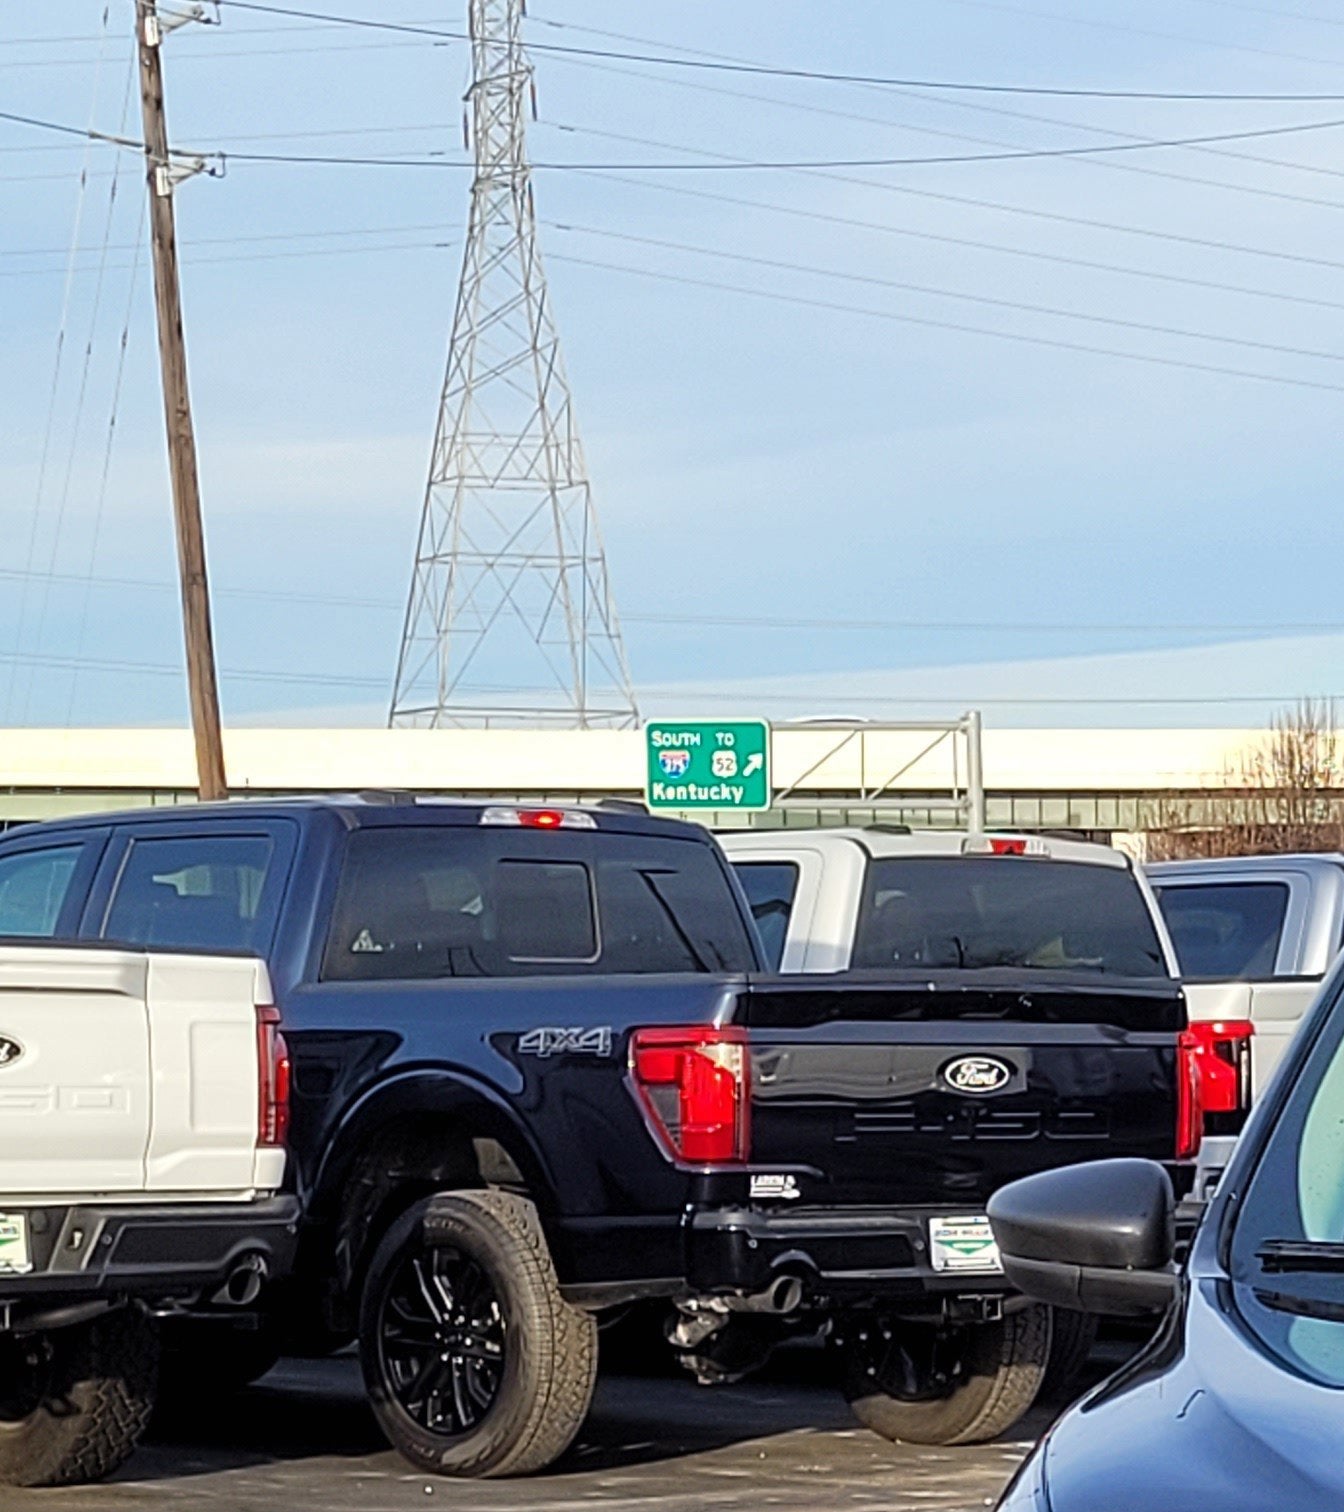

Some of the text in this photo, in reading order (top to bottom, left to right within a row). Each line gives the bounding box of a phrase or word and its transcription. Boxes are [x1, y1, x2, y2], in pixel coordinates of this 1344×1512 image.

[651, 730, 735, 747] SOUTH TO
[715, 757, 734, 772] 52
[652, 782, 744, 804] Kentucky
[956, 1062, 1000, 1086] Ford
